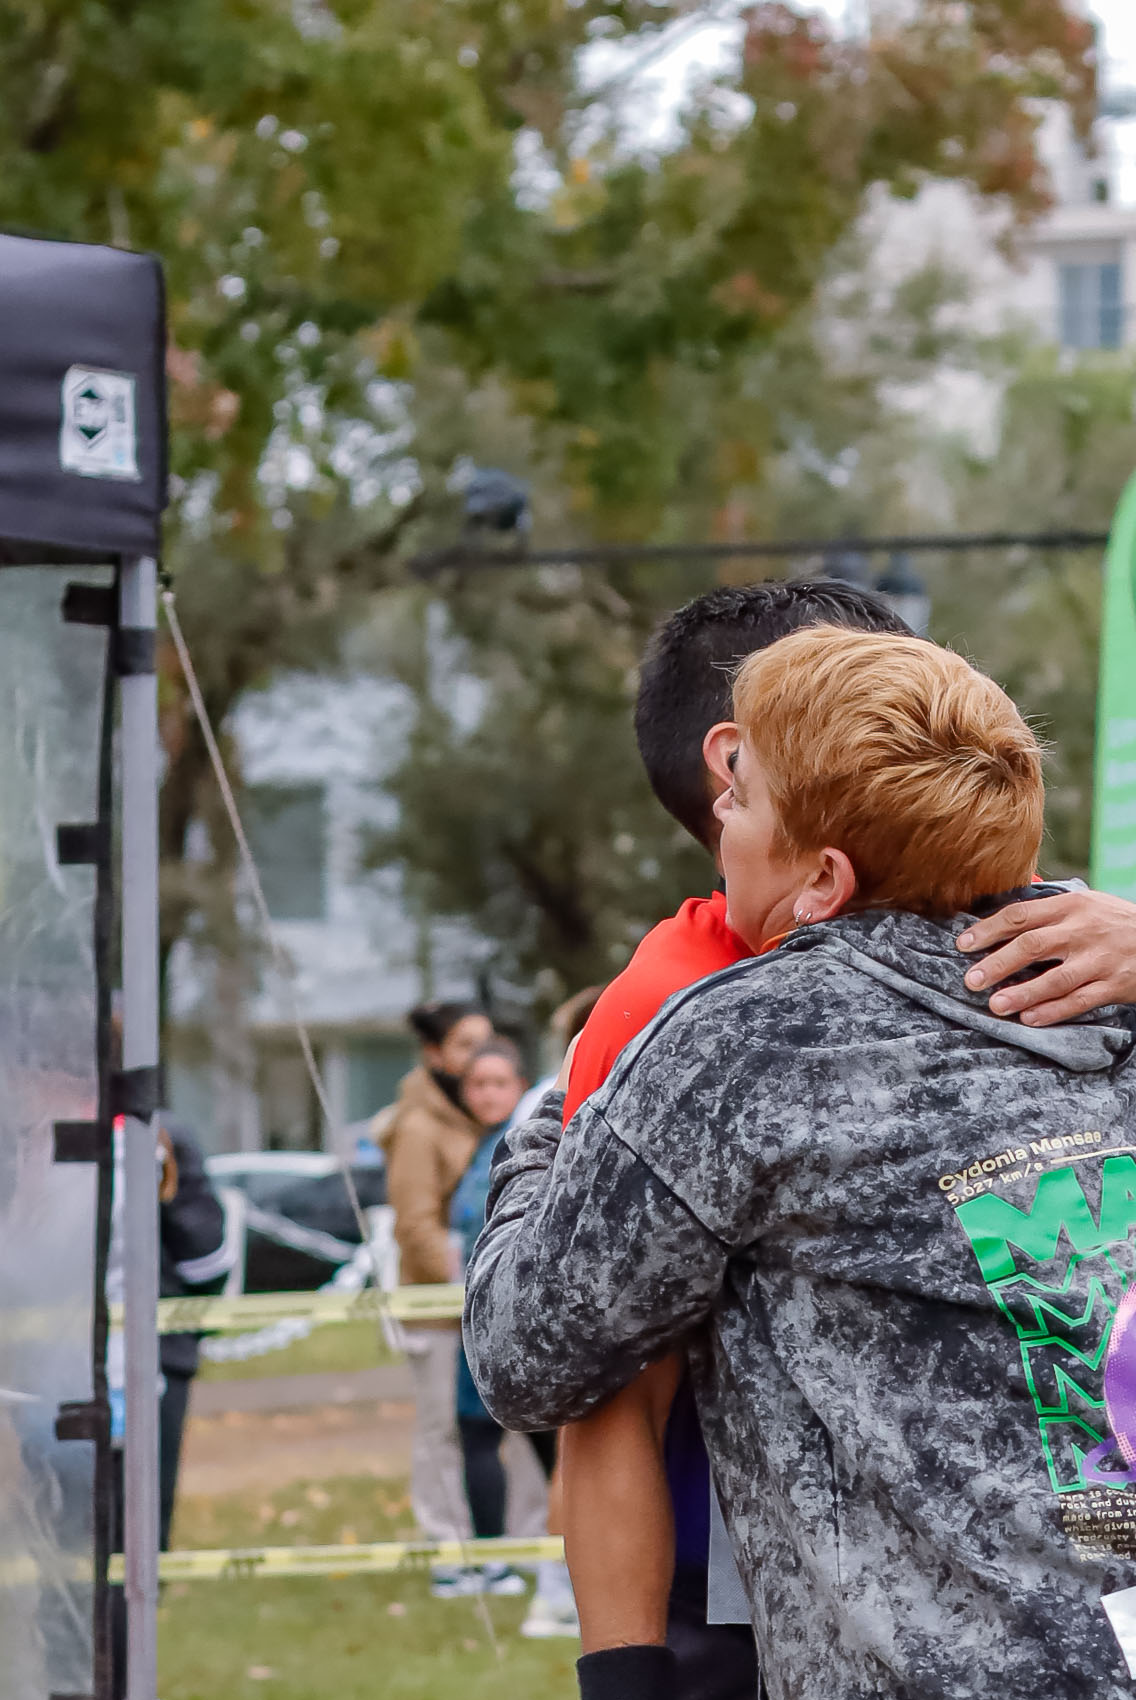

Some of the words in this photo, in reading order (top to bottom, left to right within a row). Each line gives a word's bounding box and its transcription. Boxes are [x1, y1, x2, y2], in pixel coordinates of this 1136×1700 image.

[938, 1149, 1028, 1191] Cydonia
[1029, 1131, 1101, 1155] Mensae
[1091, 1498, 1111, 1508] and
[1097, 1510, 1122, 1520] from
